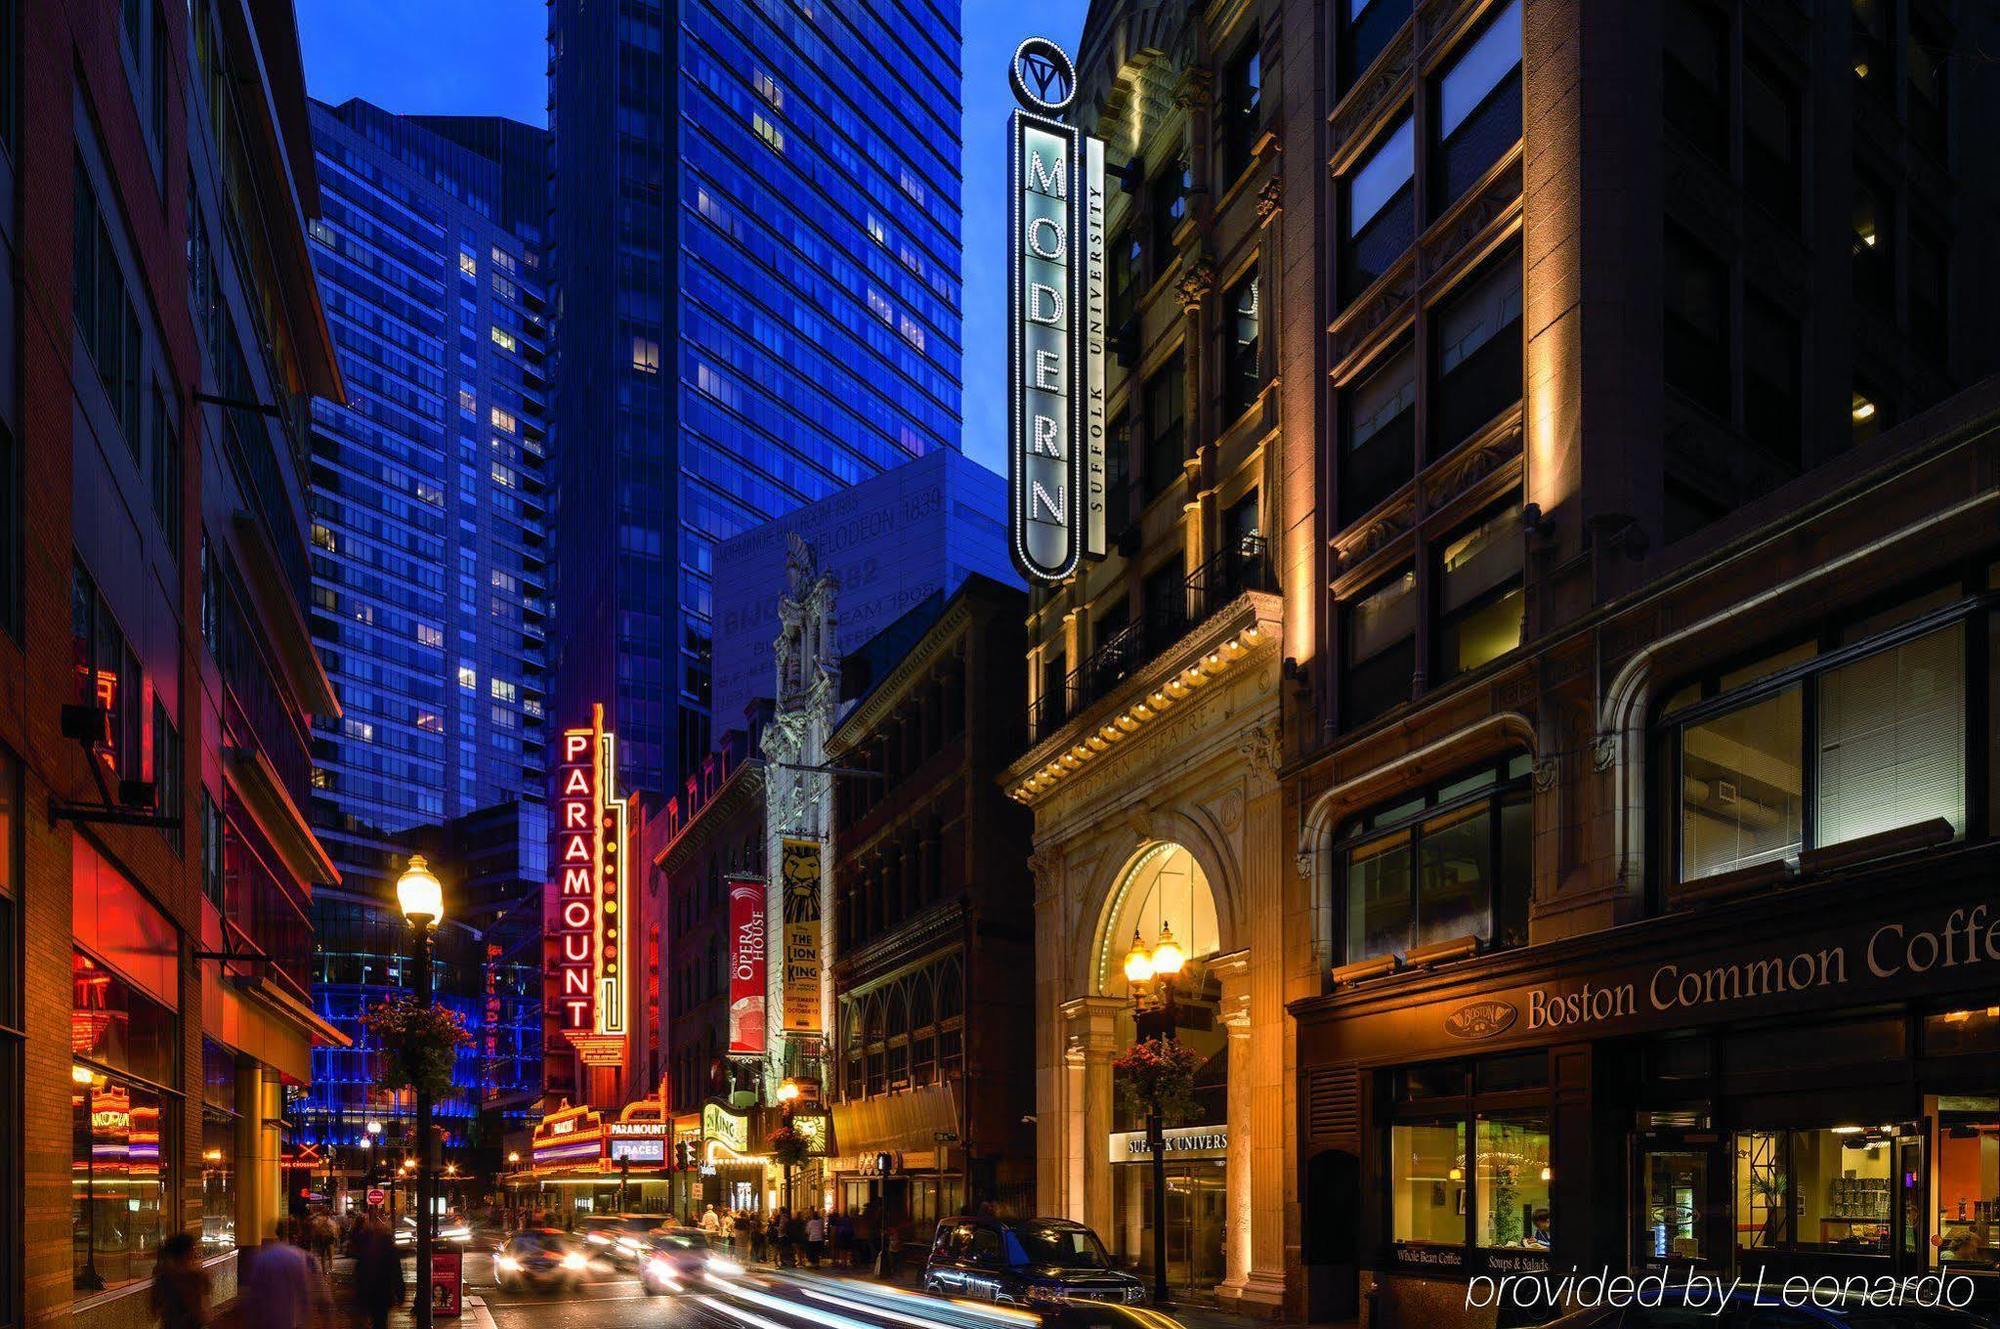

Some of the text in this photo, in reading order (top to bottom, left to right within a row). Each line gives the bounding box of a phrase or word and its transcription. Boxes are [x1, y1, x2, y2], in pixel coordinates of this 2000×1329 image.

[1027, 150, 1067, 526] MODERN
[1090, 186, 1103, 513] SUFFOLK UNIVERSITY
[564, 735, 591, 1028] PARAMOUNT
[737, 922, 753, 980] OPERA
[753, 911, 764, 961] HOUSE
[792, 934, 812, 944] THE
[787, 945, 816, 962] LION
[788, 964, 817, 982] KING
[1526, 982, 1638, 1031] Boston
[1650, 945, 1848, 1011] Common
[1464, 1004, 1495, 1025] BOSTON
[611, 1124, 667, 1135] PARAMOUNT
[618, 1145, 660, 1156] TRACES
[1420, 1251, 1438, 1264] Bean
[1438, 1252, 1462, 1265] Coffee
[1488, 1255, 1549, 1272] Soups & Salads
